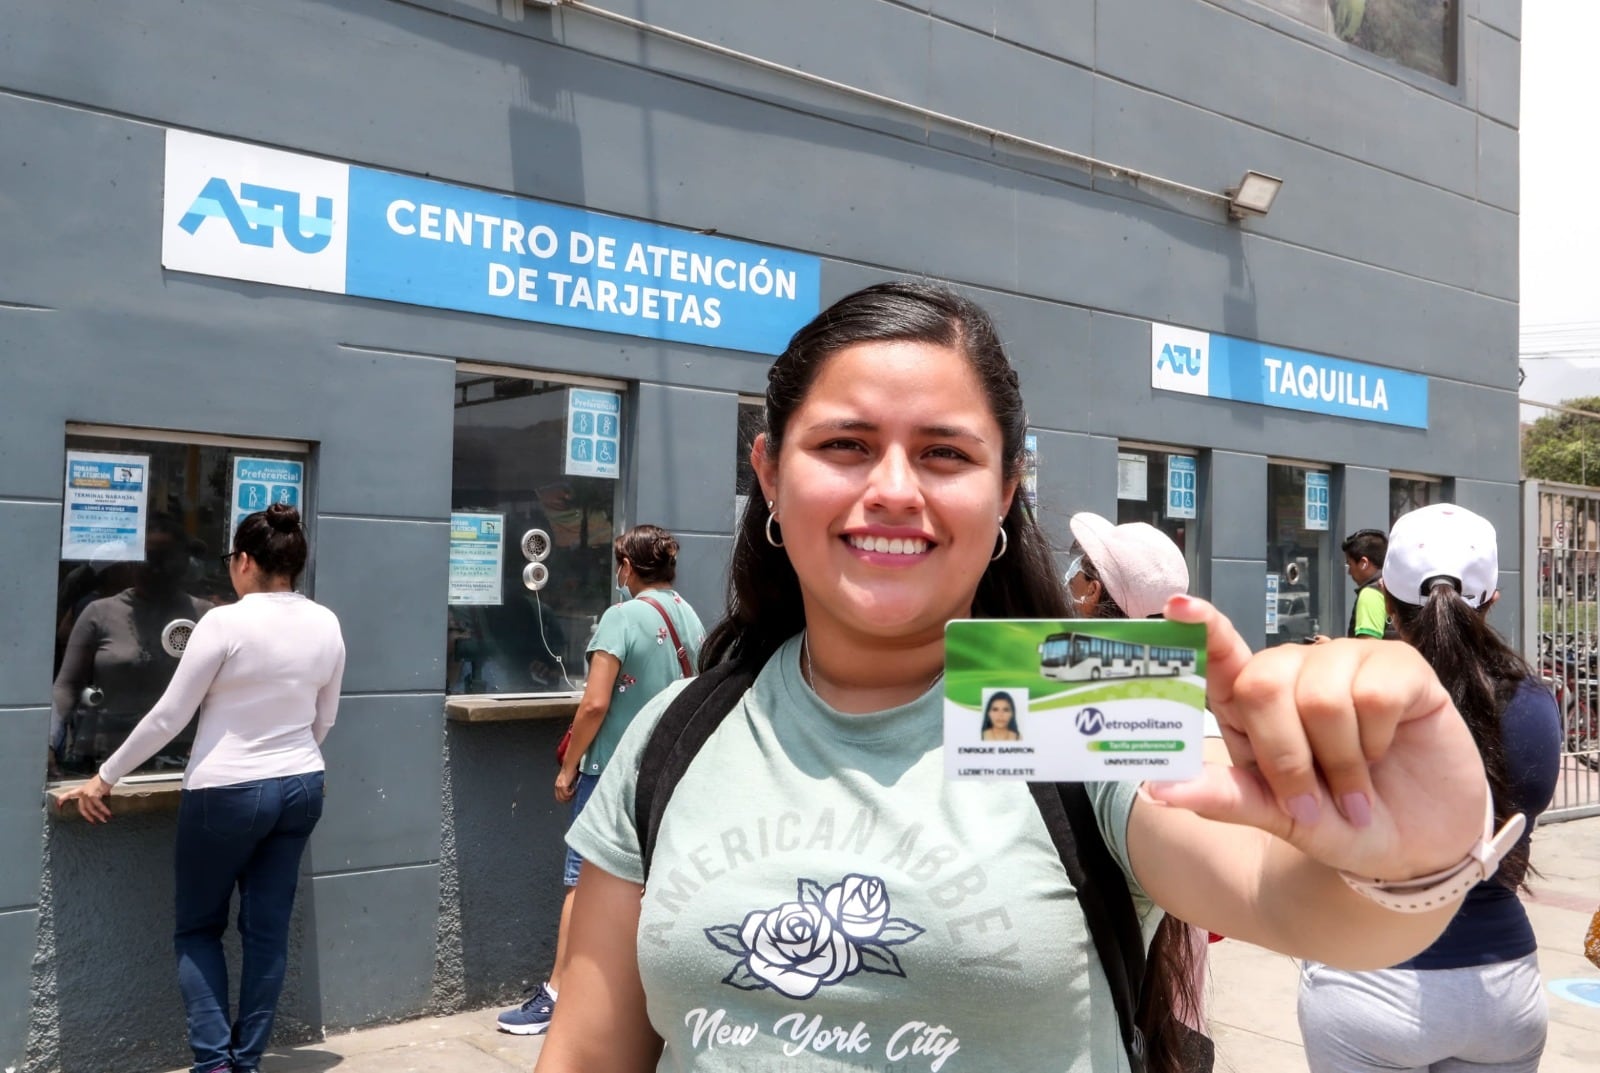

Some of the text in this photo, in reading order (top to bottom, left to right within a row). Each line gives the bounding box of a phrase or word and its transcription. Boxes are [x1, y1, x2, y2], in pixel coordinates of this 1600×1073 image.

[177, 176, 333, 254] ATU
[386, 199, 796, 300] CENTRO DE ATENCIÓN
[488, 263, 721, 328] DE TARJETAS
[1157, 343, 1201, 376] ATU
[1264, 358, 1389, 411] TAQUILLA
[241, 469, 299, 481] Preferencial
[1075, 707, 1183, 736] Metropolitano
[1109, 741, 1177, 751] Tarifa preferencial
[958, 768, 1035, 776] LIZBETH CELESTE
[643, 806, 1021, 974] AMERICAN ABBEY
[684, 1007, 961, 1073] New York City
